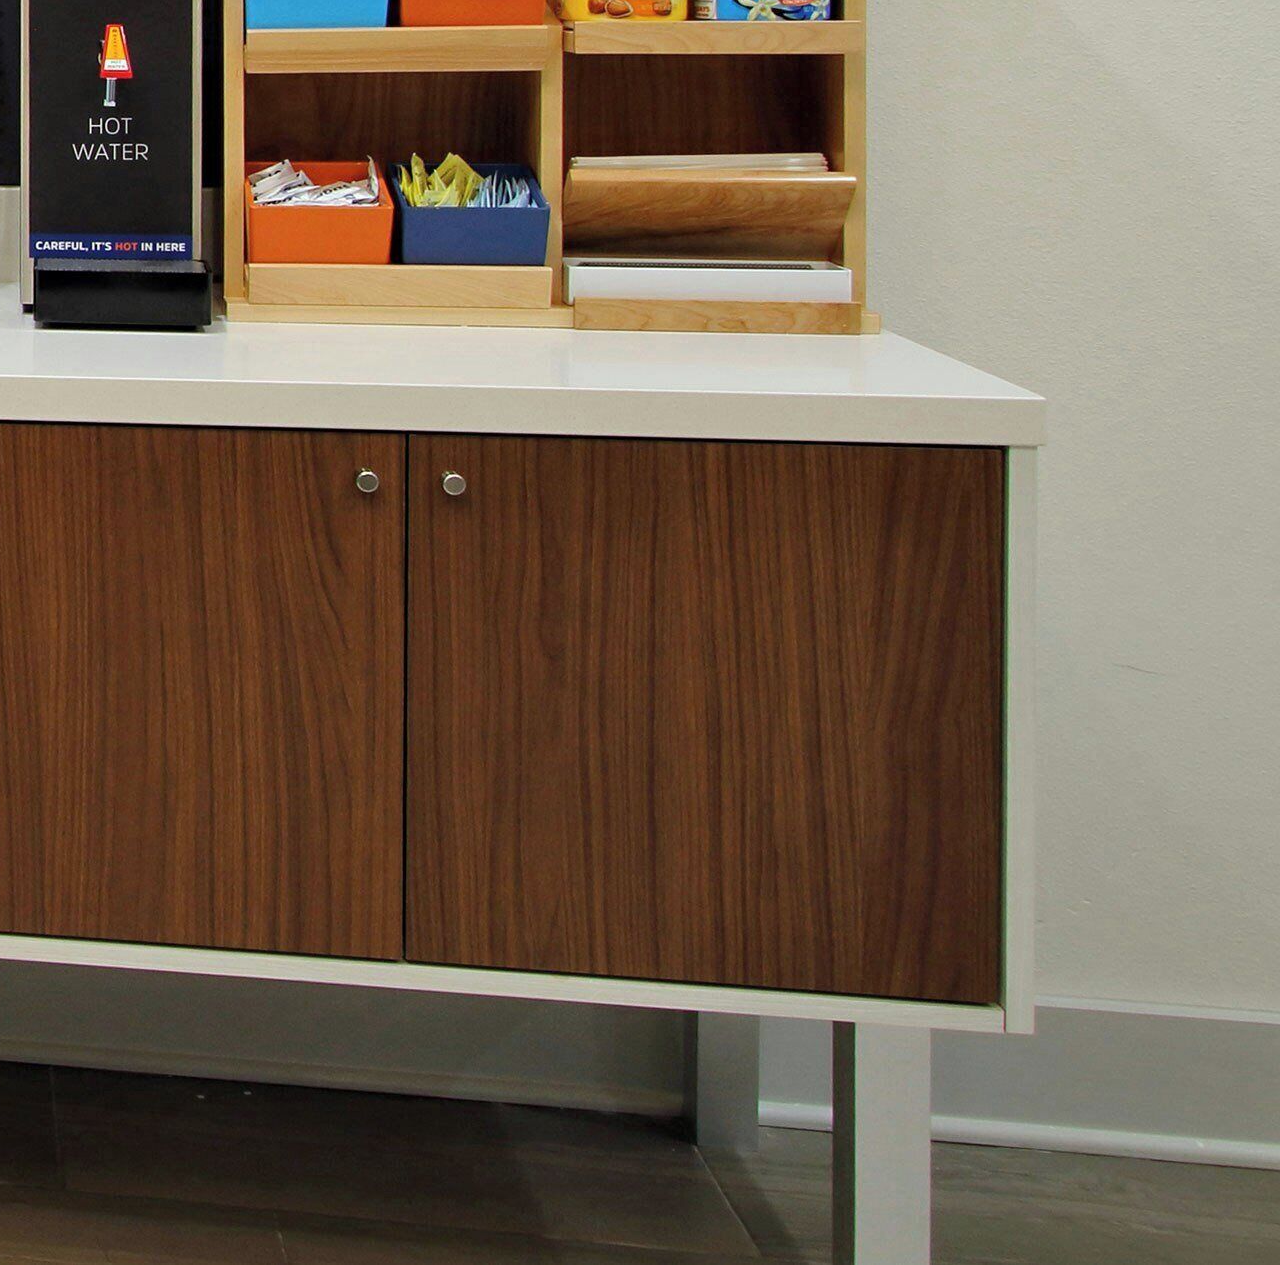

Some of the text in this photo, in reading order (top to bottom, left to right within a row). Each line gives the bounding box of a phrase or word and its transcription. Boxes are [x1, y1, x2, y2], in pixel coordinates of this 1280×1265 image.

[88, 117, 133, 135] HOT
[72, 143, 149, 161] WATER
[35, 241, 186, 252] CAREFUL, IT'S HOT IN HERE
